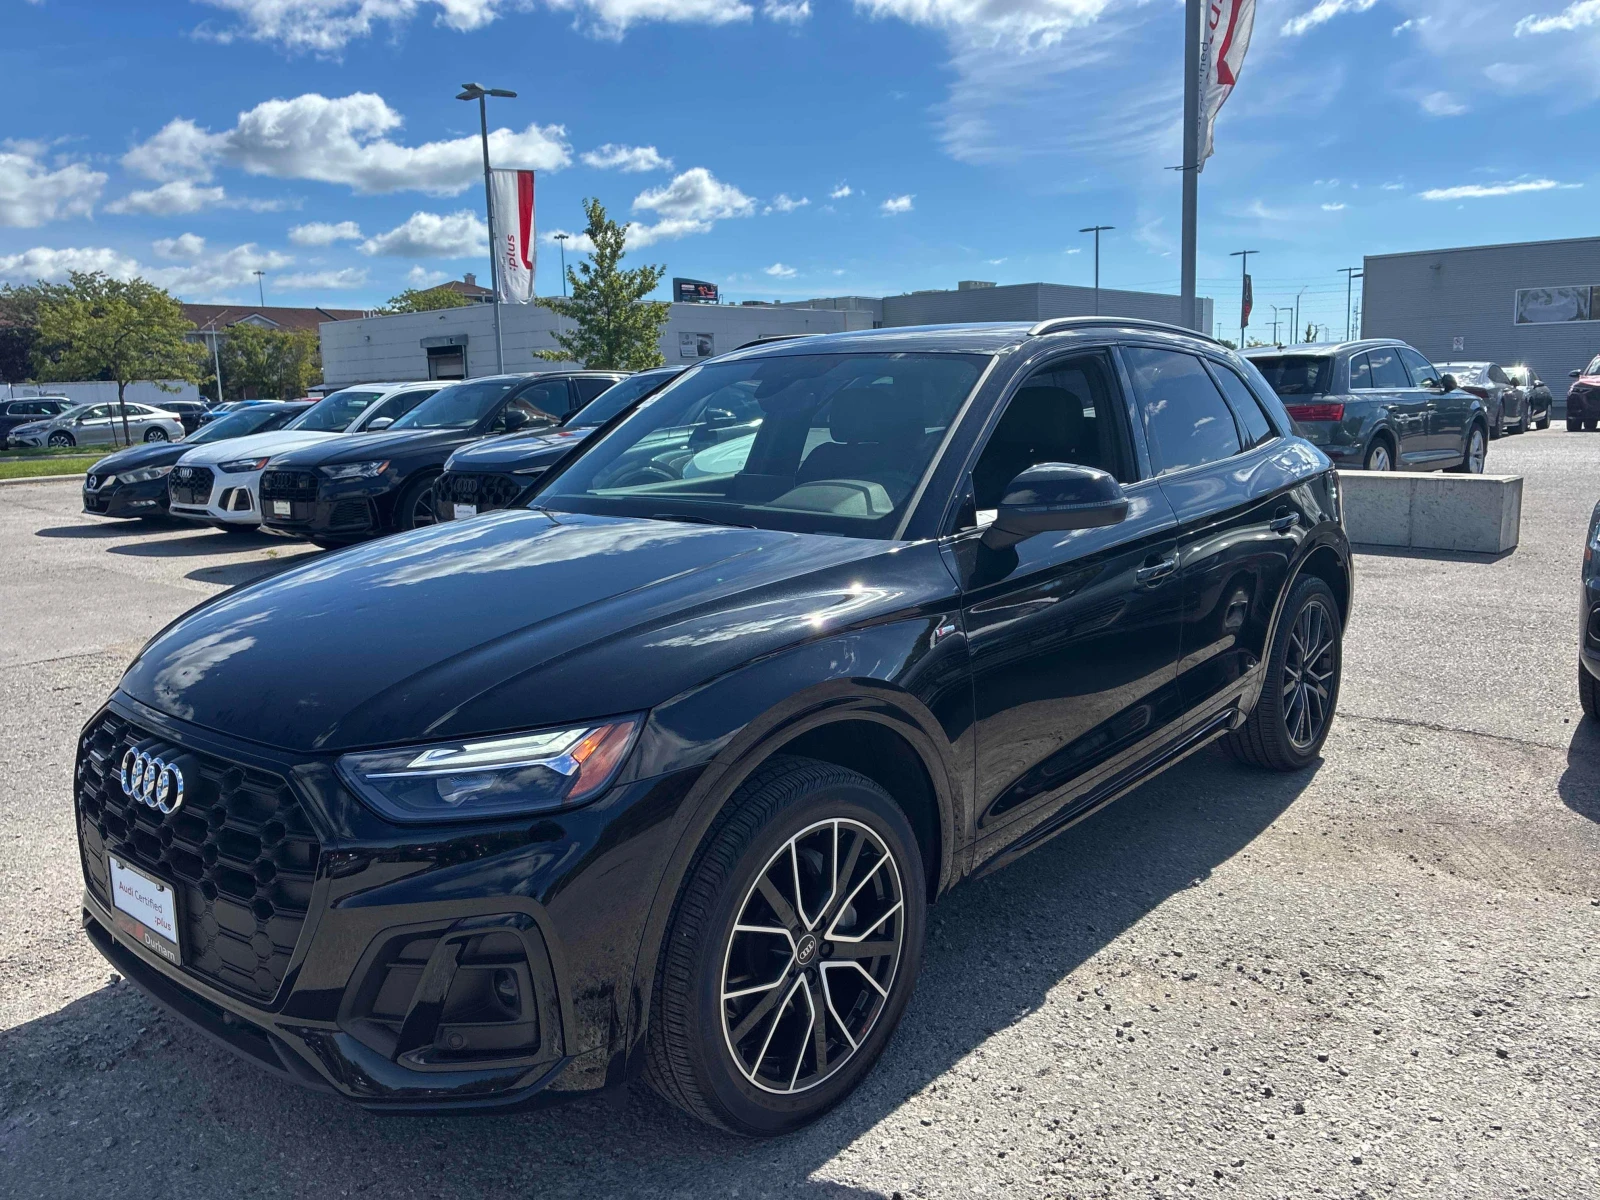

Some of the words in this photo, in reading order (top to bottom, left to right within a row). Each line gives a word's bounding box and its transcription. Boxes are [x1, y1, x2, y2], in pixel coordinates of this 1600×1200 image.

[507, 234, 518, 271] :plus
[119, 881, 133, 897] Audi
[135, 890, 162, 913] Certified
[155, 916, 171, 931] :plus
[144, 932, 175, 961] Durham
